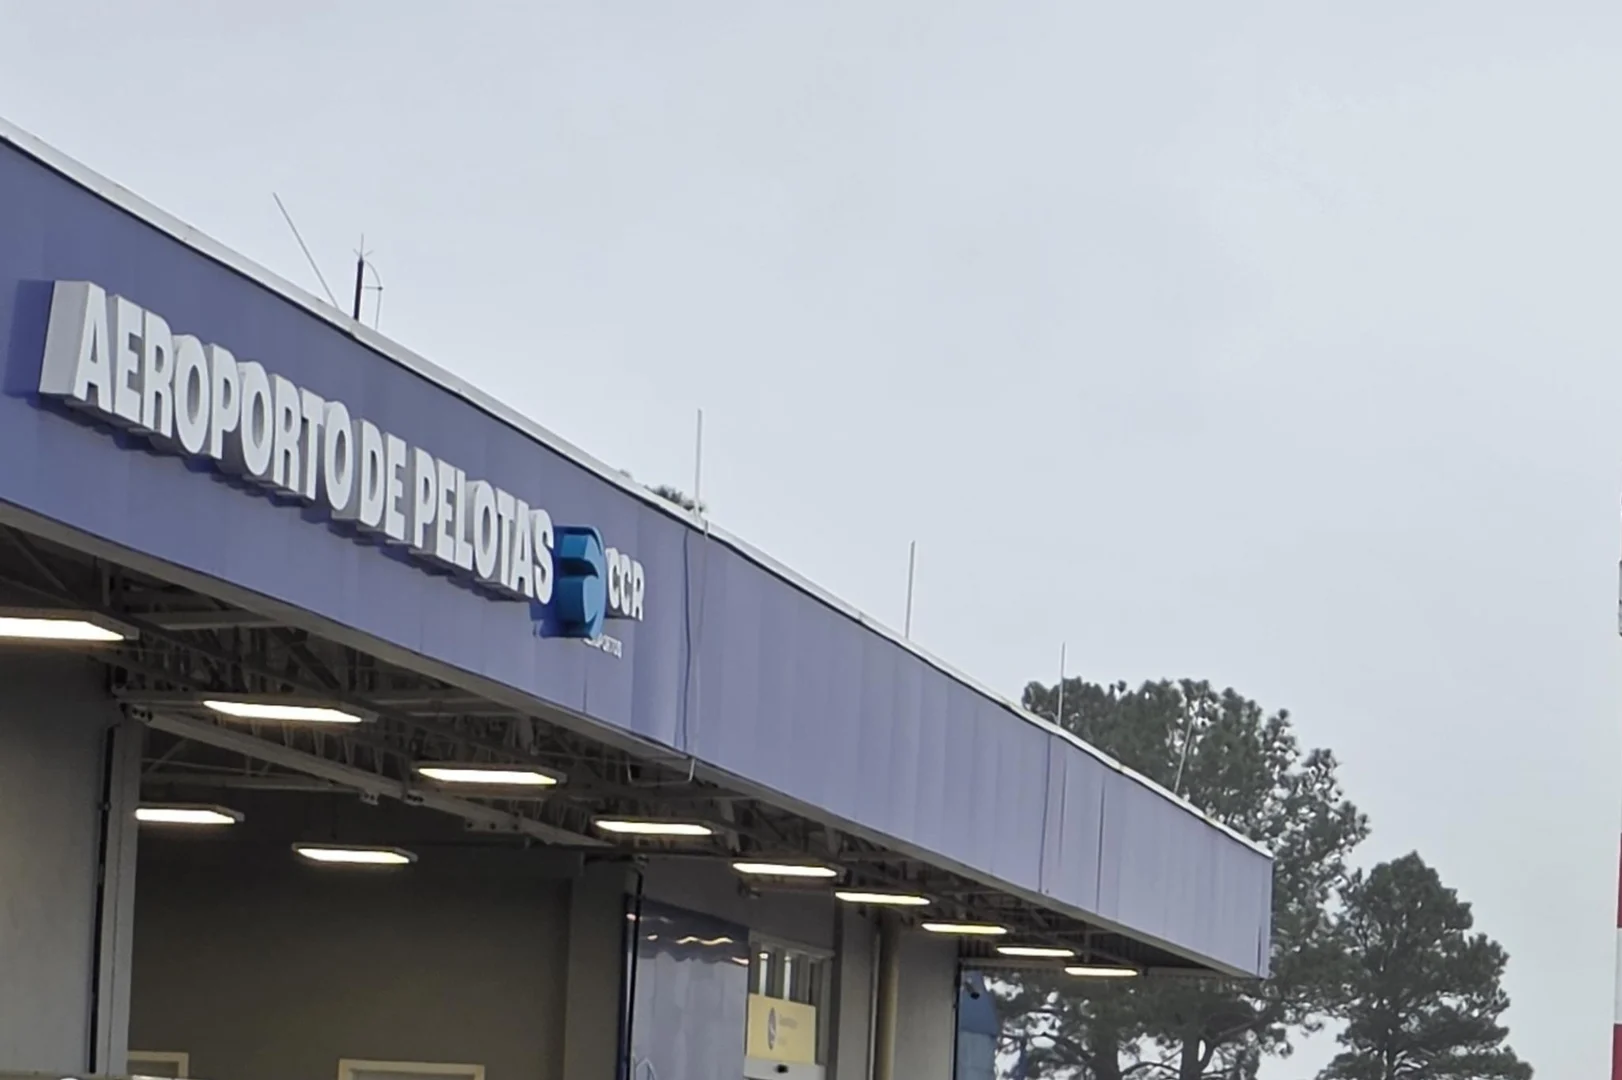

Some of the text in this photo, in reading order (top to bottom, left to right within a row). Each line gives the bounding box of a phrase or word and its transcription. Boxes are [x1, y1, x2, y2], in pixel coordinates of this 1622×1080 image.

[40, 279, 554, 606] AEROPORTO DE PELOTAS
[605, 547, 645, 621] CCR
